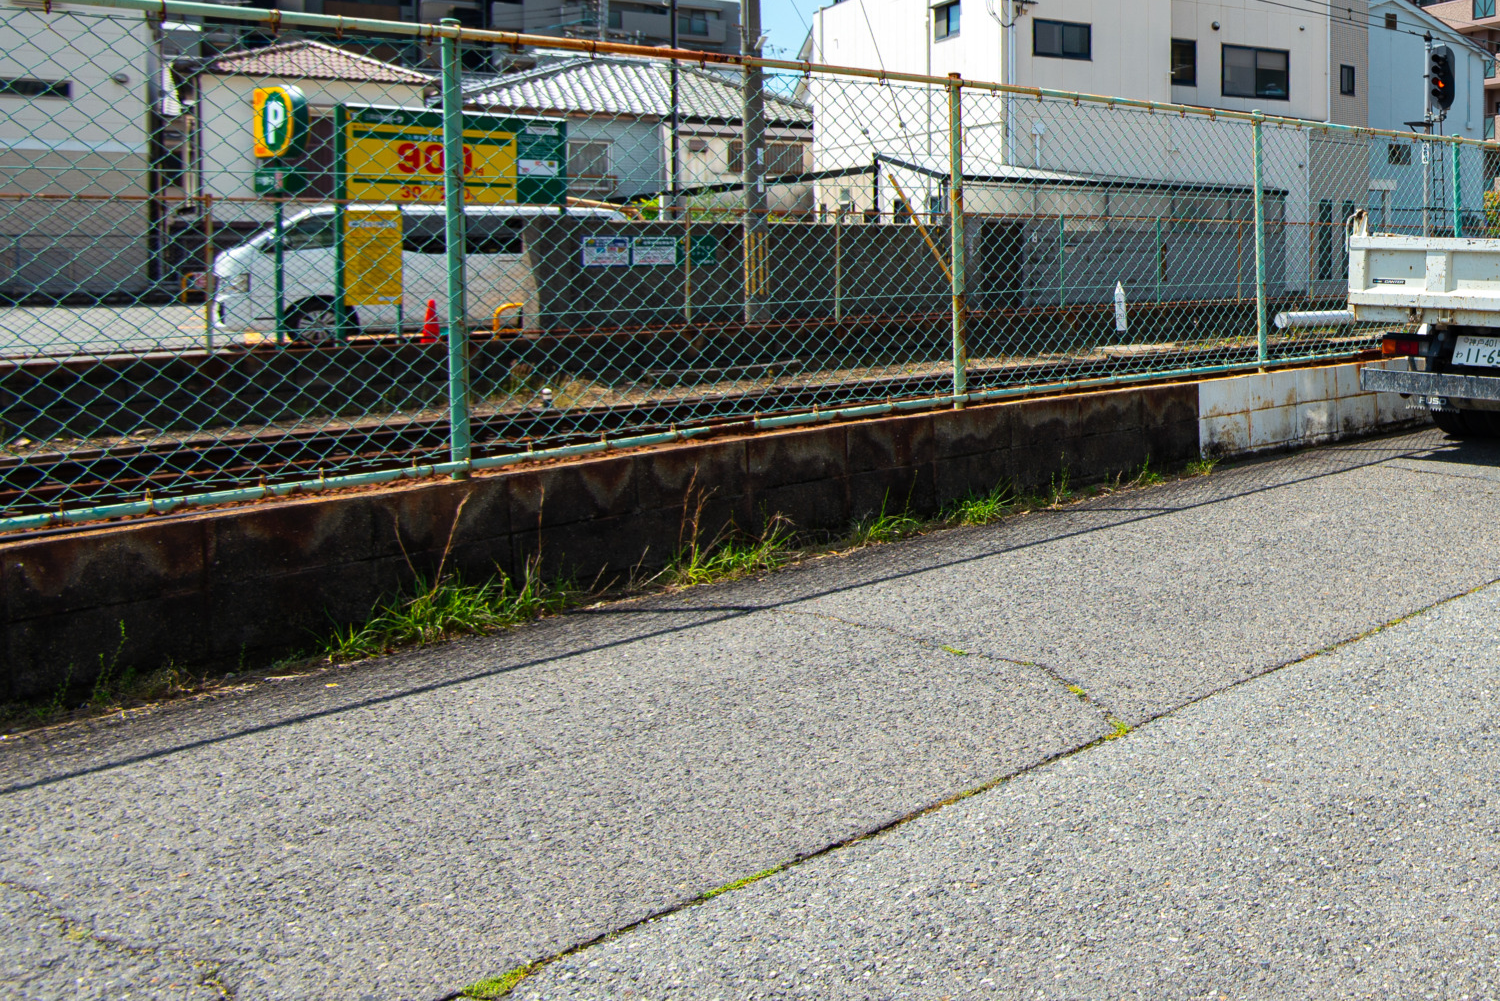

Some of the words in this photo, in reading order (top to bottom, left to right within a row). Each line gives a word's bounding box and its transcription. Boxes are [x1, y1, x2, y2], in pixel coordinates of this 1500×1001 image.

[267, 100, 285, 145] P
[1455, 351, 1464, 359] わ
[1418, 396, 1447, 405] FUSO
